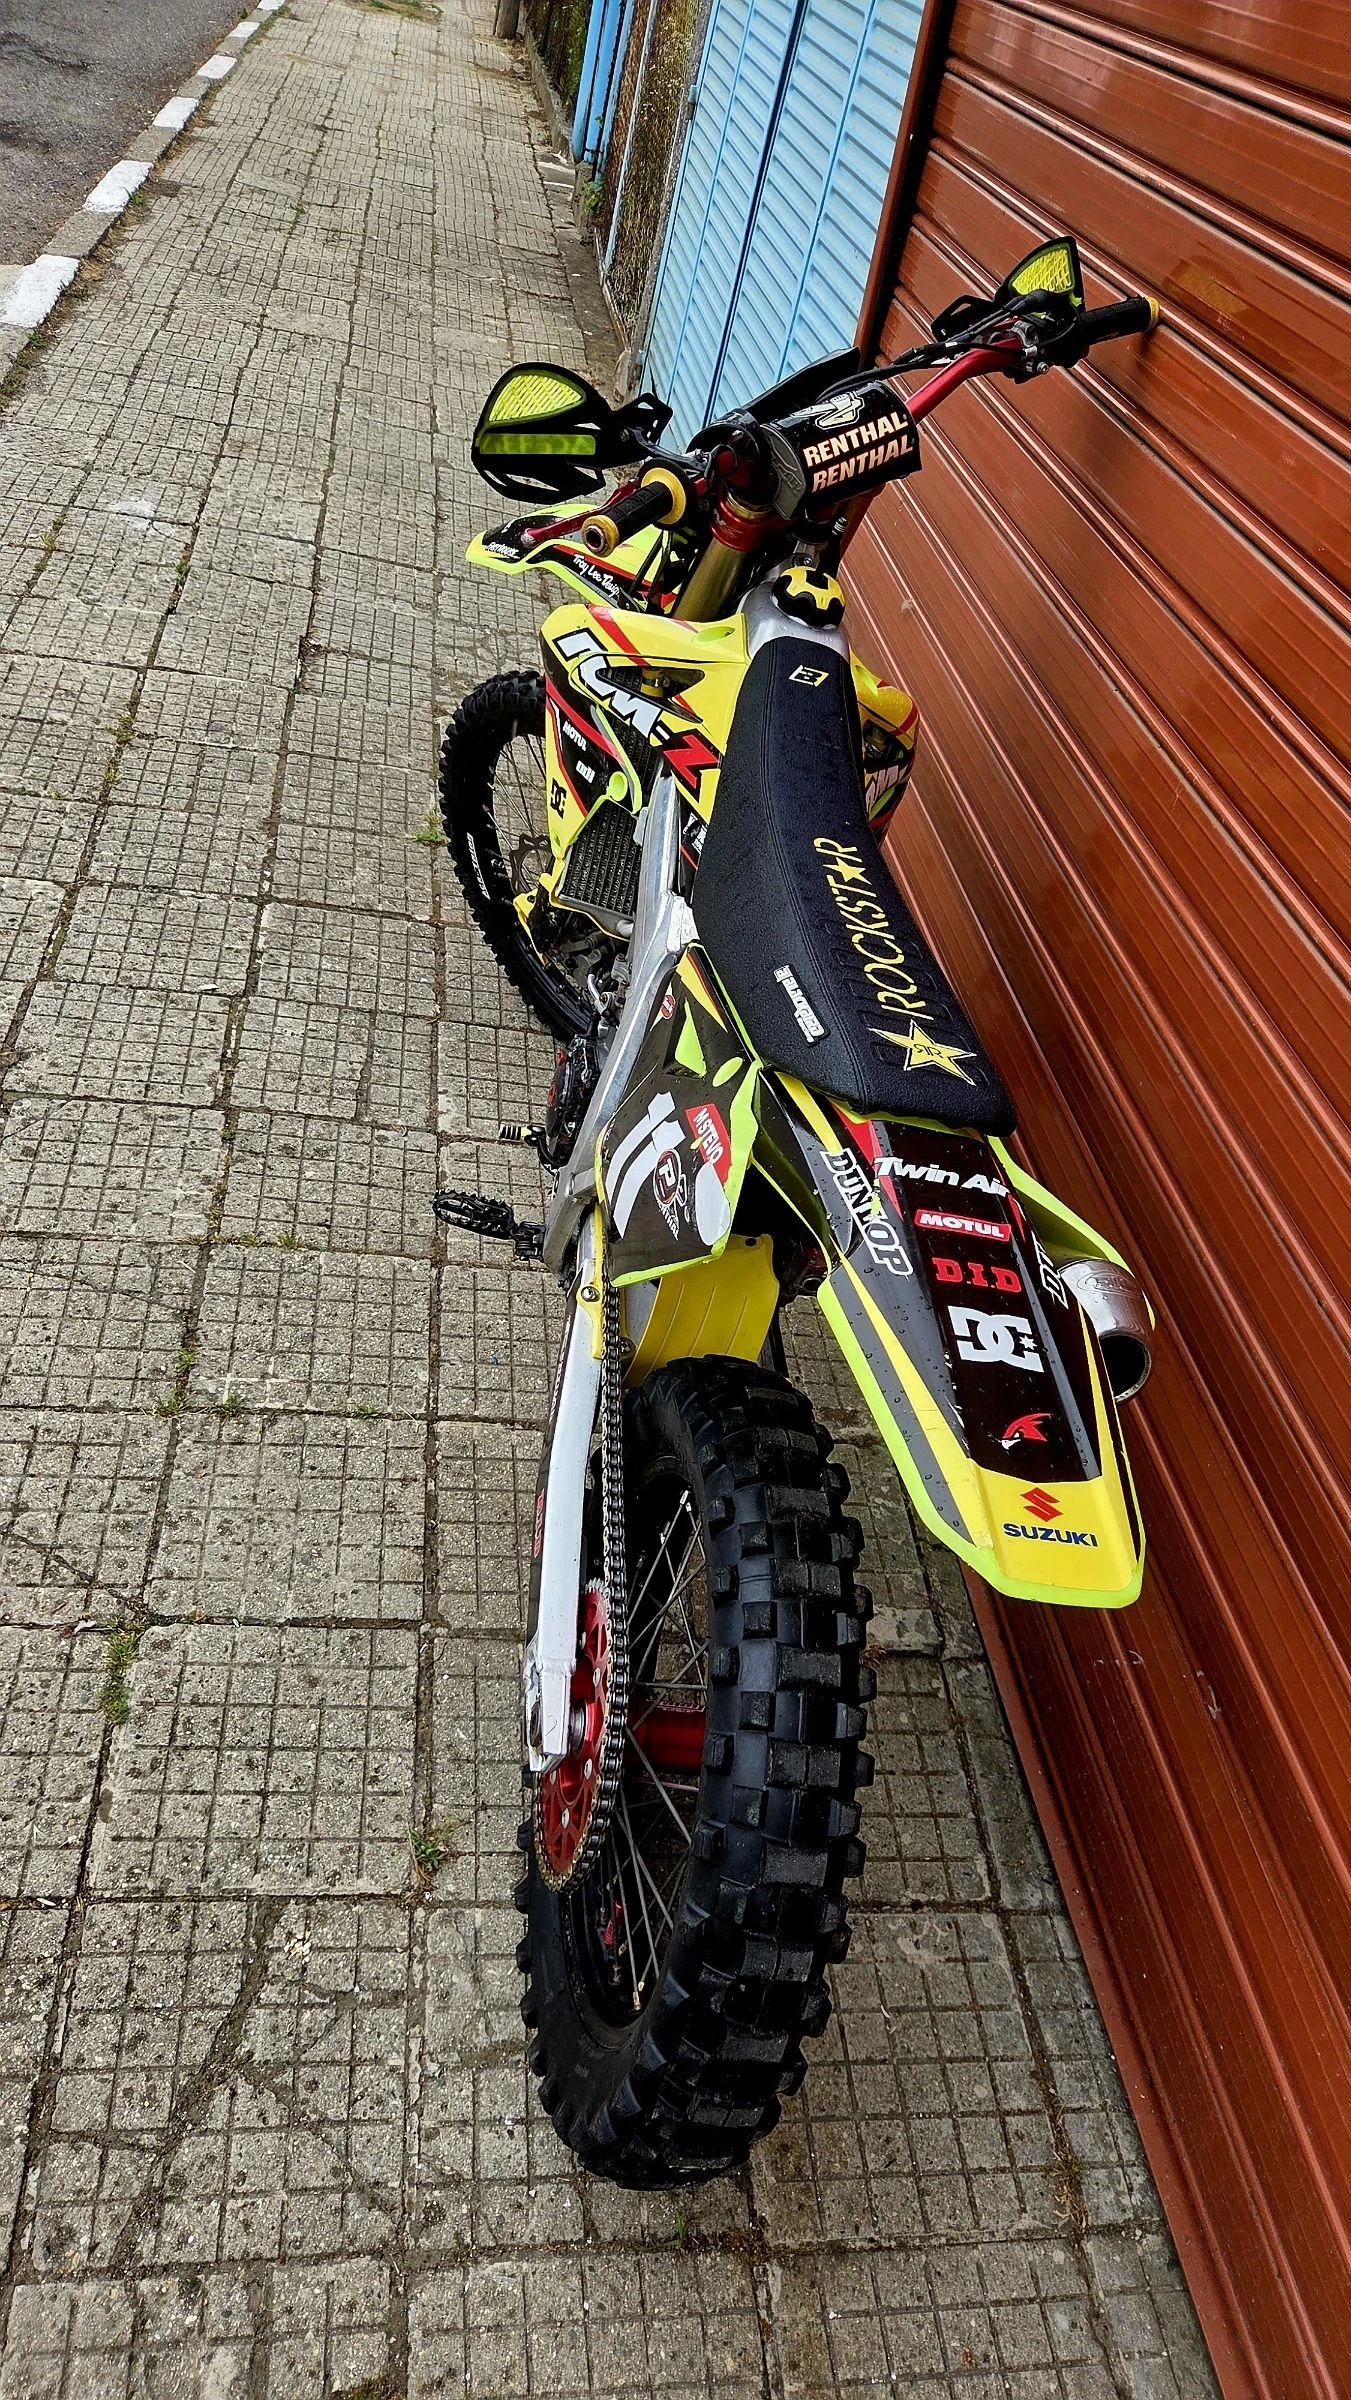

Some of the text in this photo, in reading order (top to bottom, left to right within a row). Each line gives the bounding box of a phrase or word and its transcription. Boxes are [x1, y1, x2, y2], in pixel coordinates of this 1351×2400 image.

[803, 411, 909, 468] RENTHAL
[811, 434, 914, 493] RENTHAL
[572, 554, 589, 575] Troy
[587, 565, 602, 583] Lee
[562, 720, 587, 752] MOTUL
[873, 1156, 1011, 1198] Twin Air
[657, 1199, 679, 1241] NTHAL
[919, 1213, 1005, 1239] MOTUL
[931, 1257, 1022, 1293] D.I.D
[947, 1305, 1044, 1373] DC
[1002, 1522, 1099, 1548] SUZUKI
